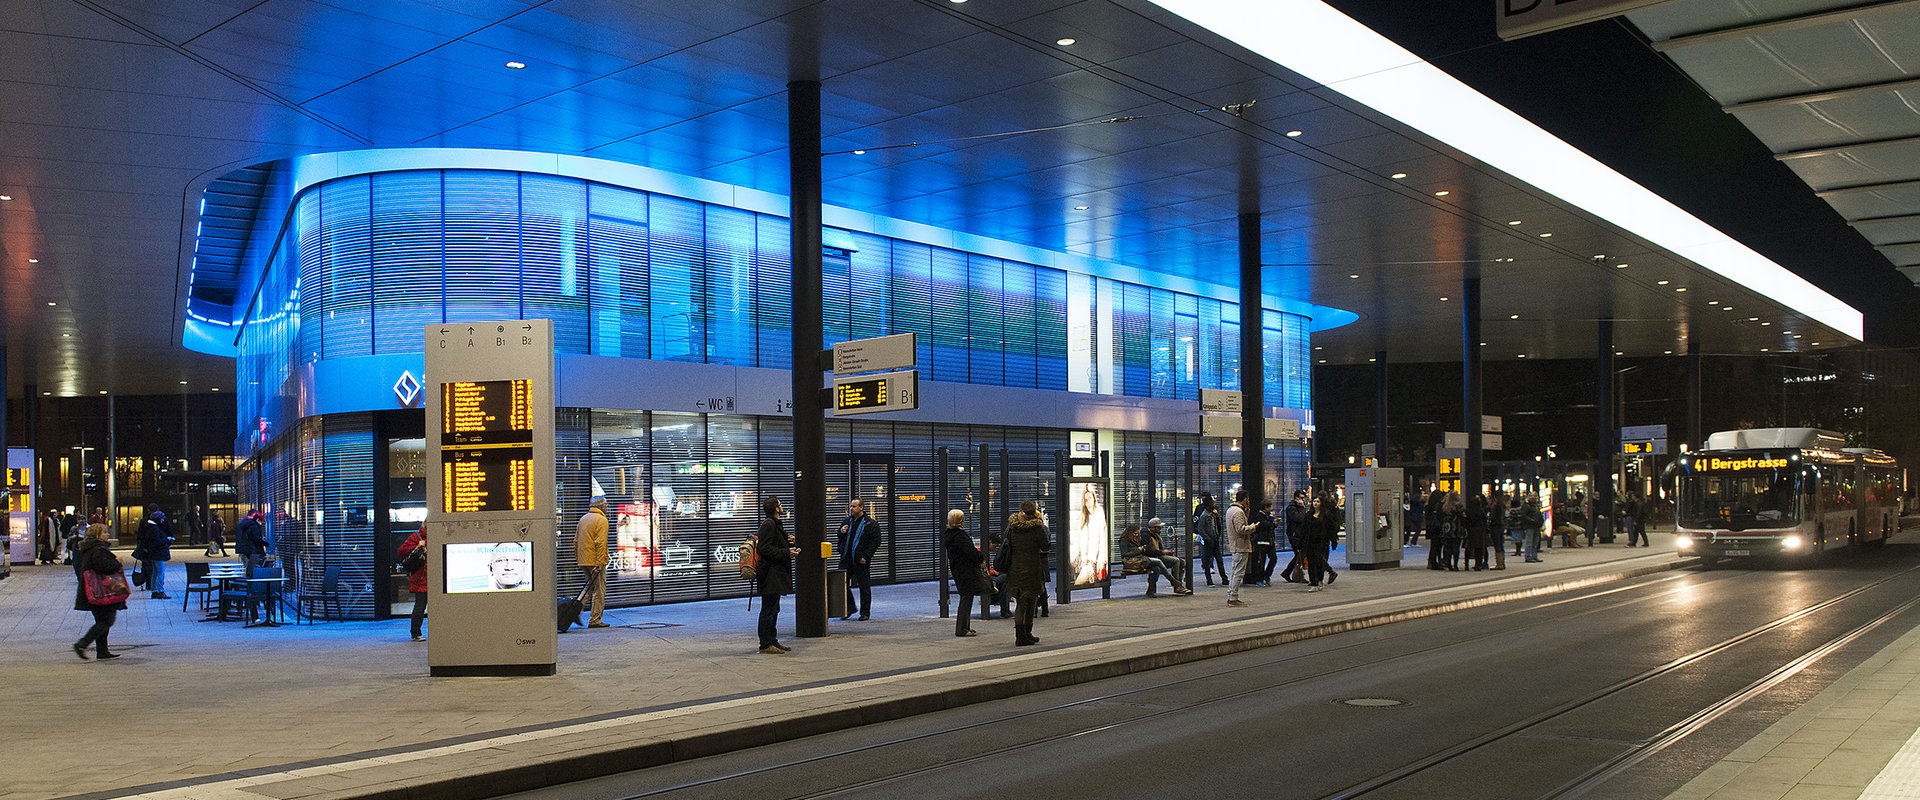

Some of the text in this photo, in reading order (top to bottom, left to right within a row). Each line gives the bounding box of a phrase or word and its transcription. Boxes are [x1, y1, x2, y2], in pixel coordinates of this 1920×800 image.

[440, 340, 446, 349] C
[467, 339, 474, 347] A
[496, 337, 506, 346] B1
[522, 335, 532, 345] B2
[708, 398, 723, 411] WC
[1694, 457, 1788, 472] 41 Bergstrasse
